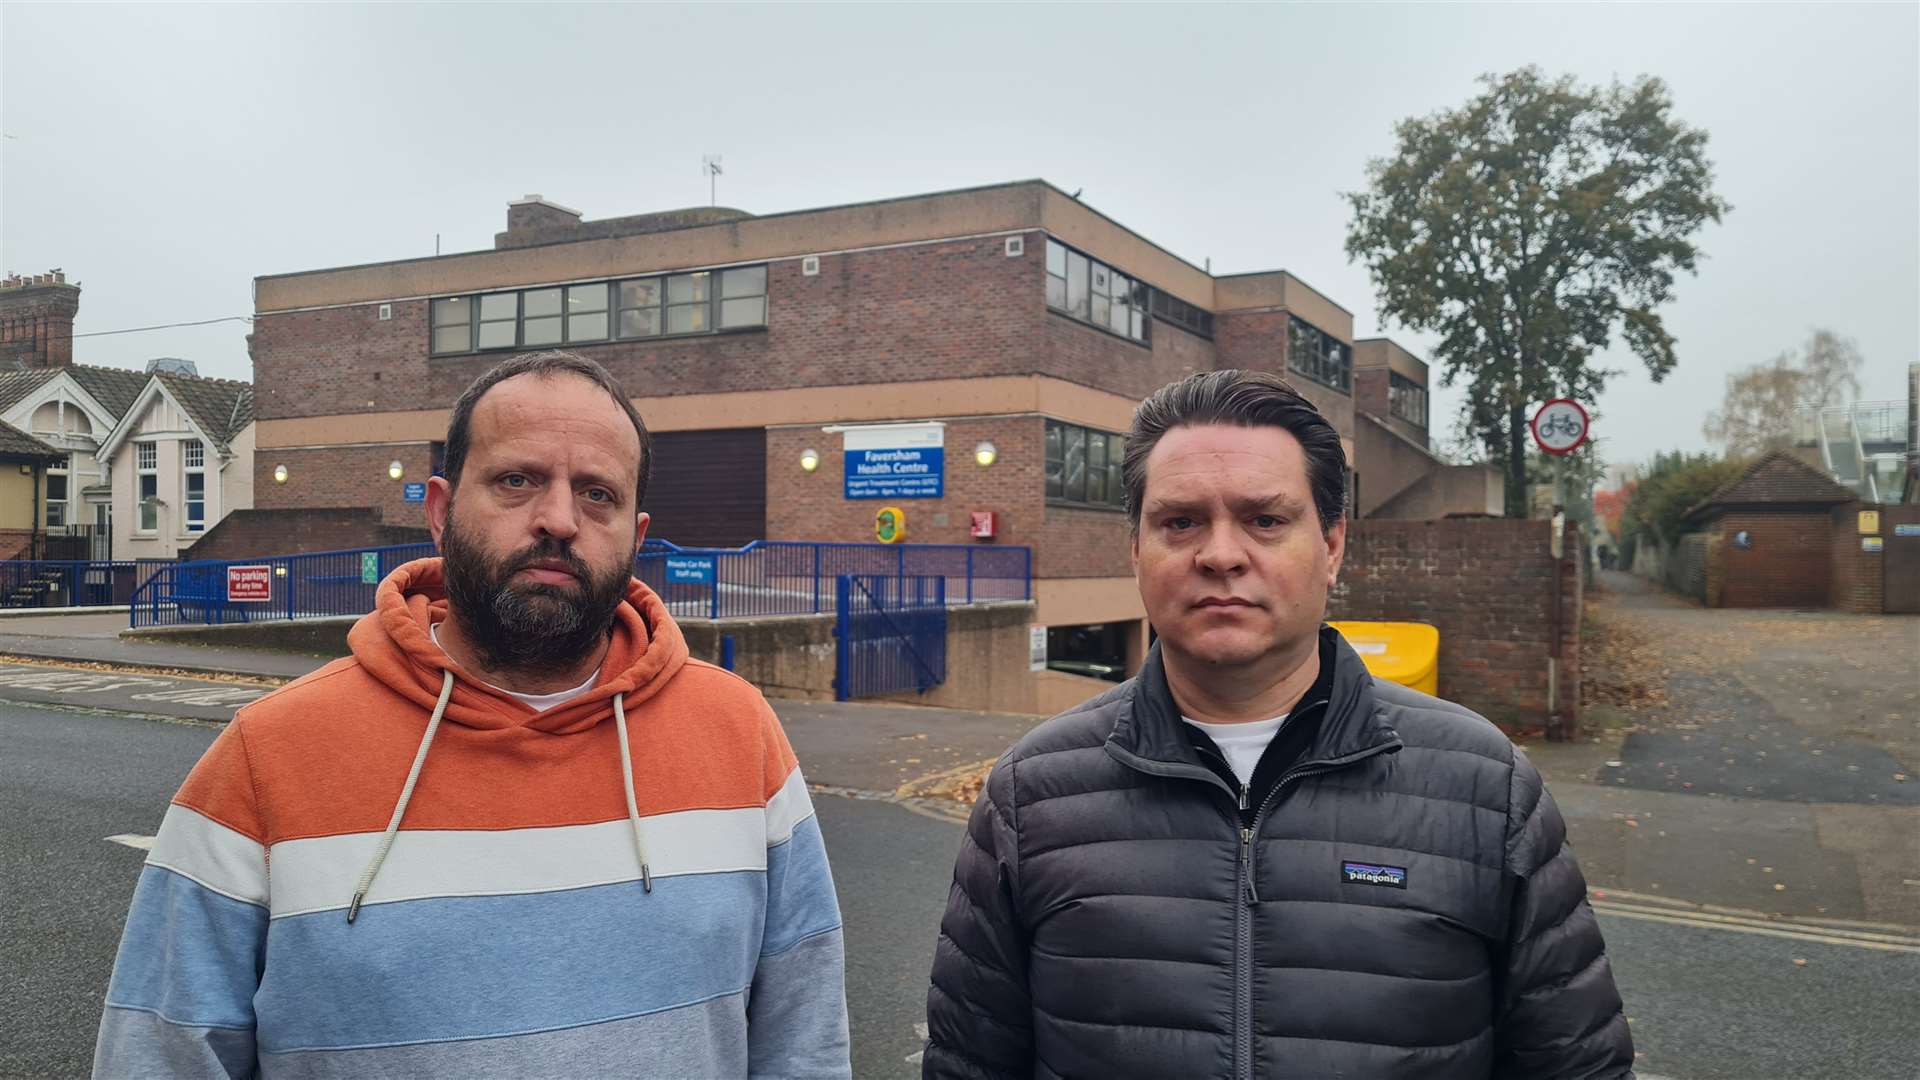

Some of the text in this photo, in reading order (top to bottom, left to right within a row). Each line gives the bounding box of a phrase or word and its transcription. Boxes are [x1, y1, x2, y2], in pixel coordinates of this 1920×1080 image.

[865, 450, 920, 462] Faversham
[858, 462, 928, 474] Health Centre
[688, 560, 698, 568] Car
[230, 570, 268, 582] No parking
[1350, 872, 1400, 884] patagonia
